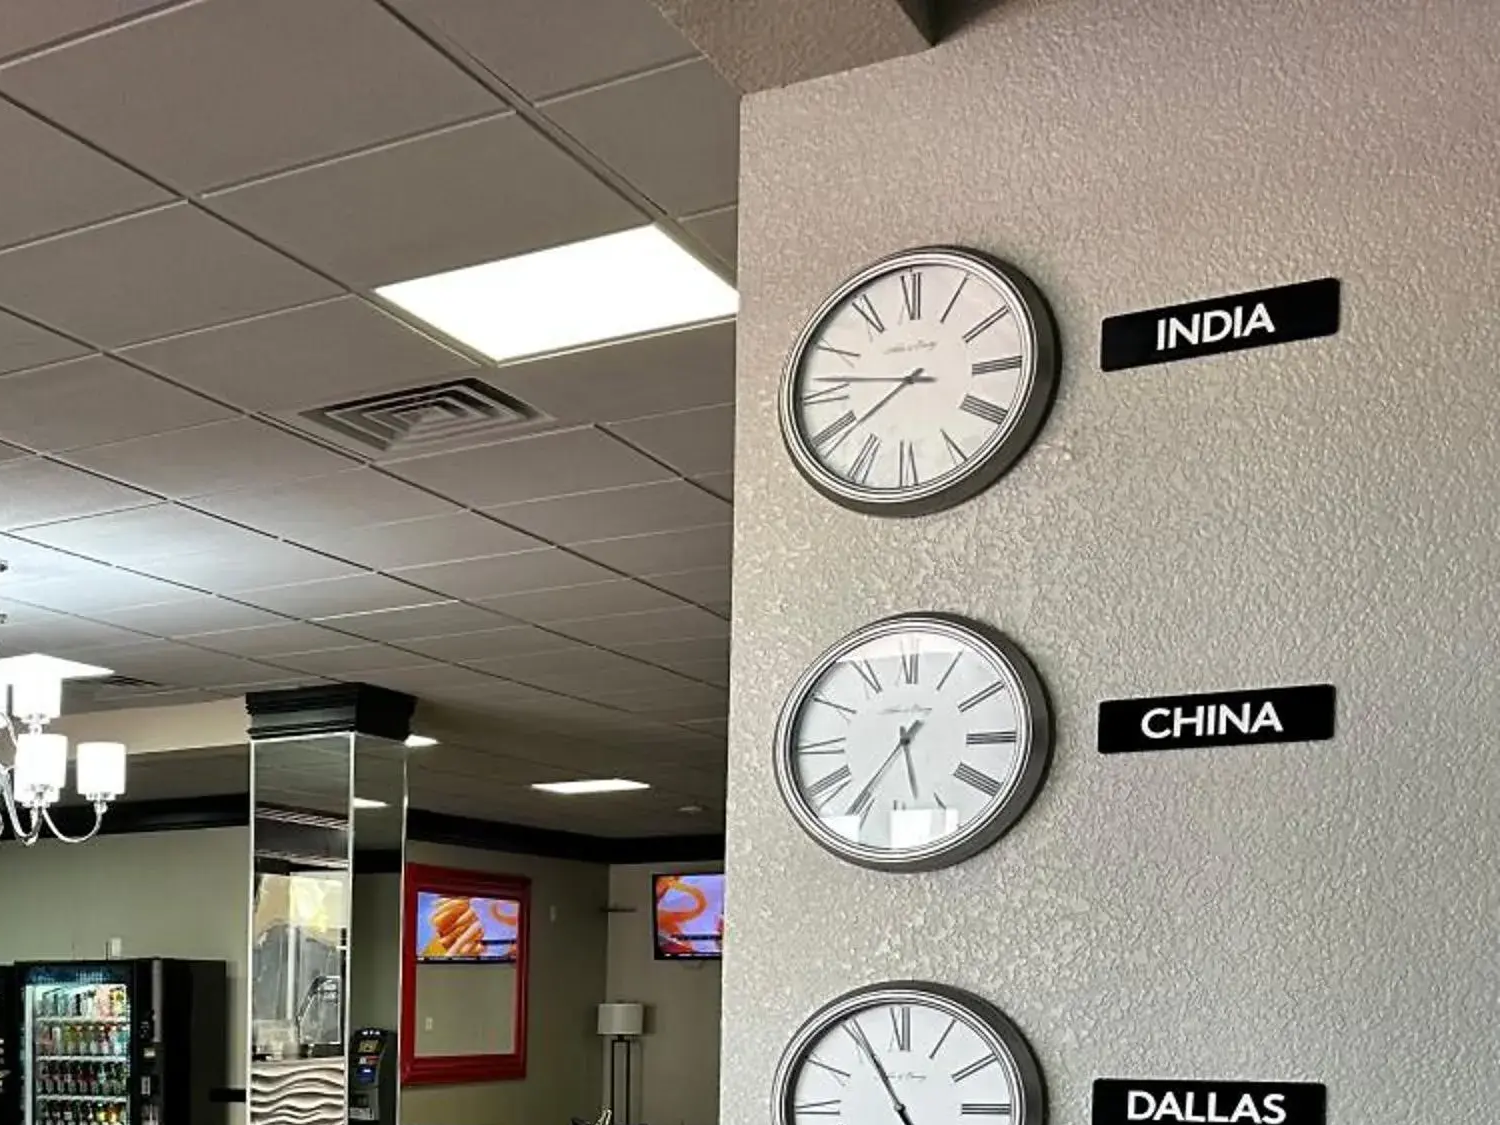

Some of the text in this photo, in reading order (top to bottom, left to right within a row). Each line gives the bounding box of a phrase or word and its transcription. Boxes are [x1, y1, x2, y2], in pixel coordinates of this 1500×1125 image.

[1156, 303, 1276, 351] INDIA
[1141, 701, 1284, 739] CHINA
[1127, 1090, 1287, 1125] DALLAS
